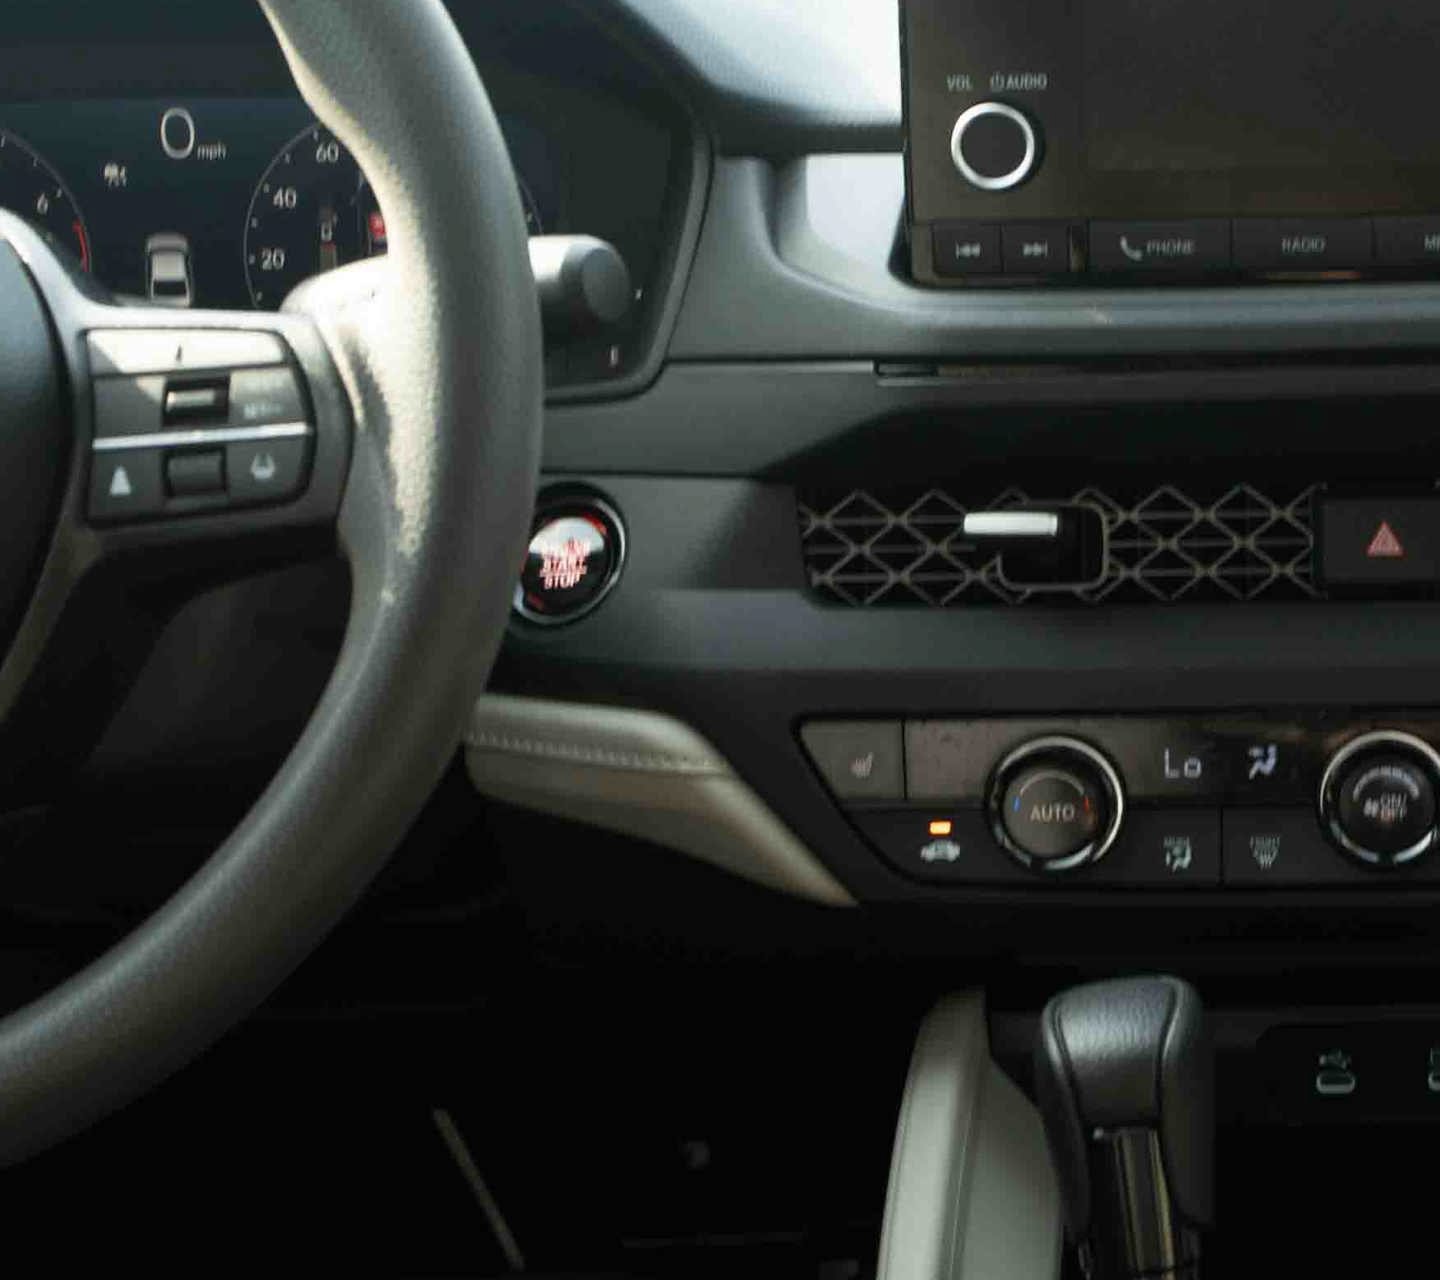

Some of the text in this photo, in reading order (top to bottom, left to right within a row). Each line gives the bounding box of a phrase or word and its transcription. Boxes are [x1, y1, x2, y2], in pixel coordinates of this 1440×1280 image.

[946, 73, 974, 91] VOL
[1006, 72, 1048, 91] AUDIO
[160, 107, 227, 163] 0 mph
[315, 142, 339, 163] 60
[273, 186, 296, 210] 40
[1146, 239, 1195, 256] PHONE
[1281, 236, 1325, 254] RADIO
[261, 248, 286, 271] 20
[1164, 747, 1202, 779] Lo
[1030, 803, 1075, 823] AUTO
